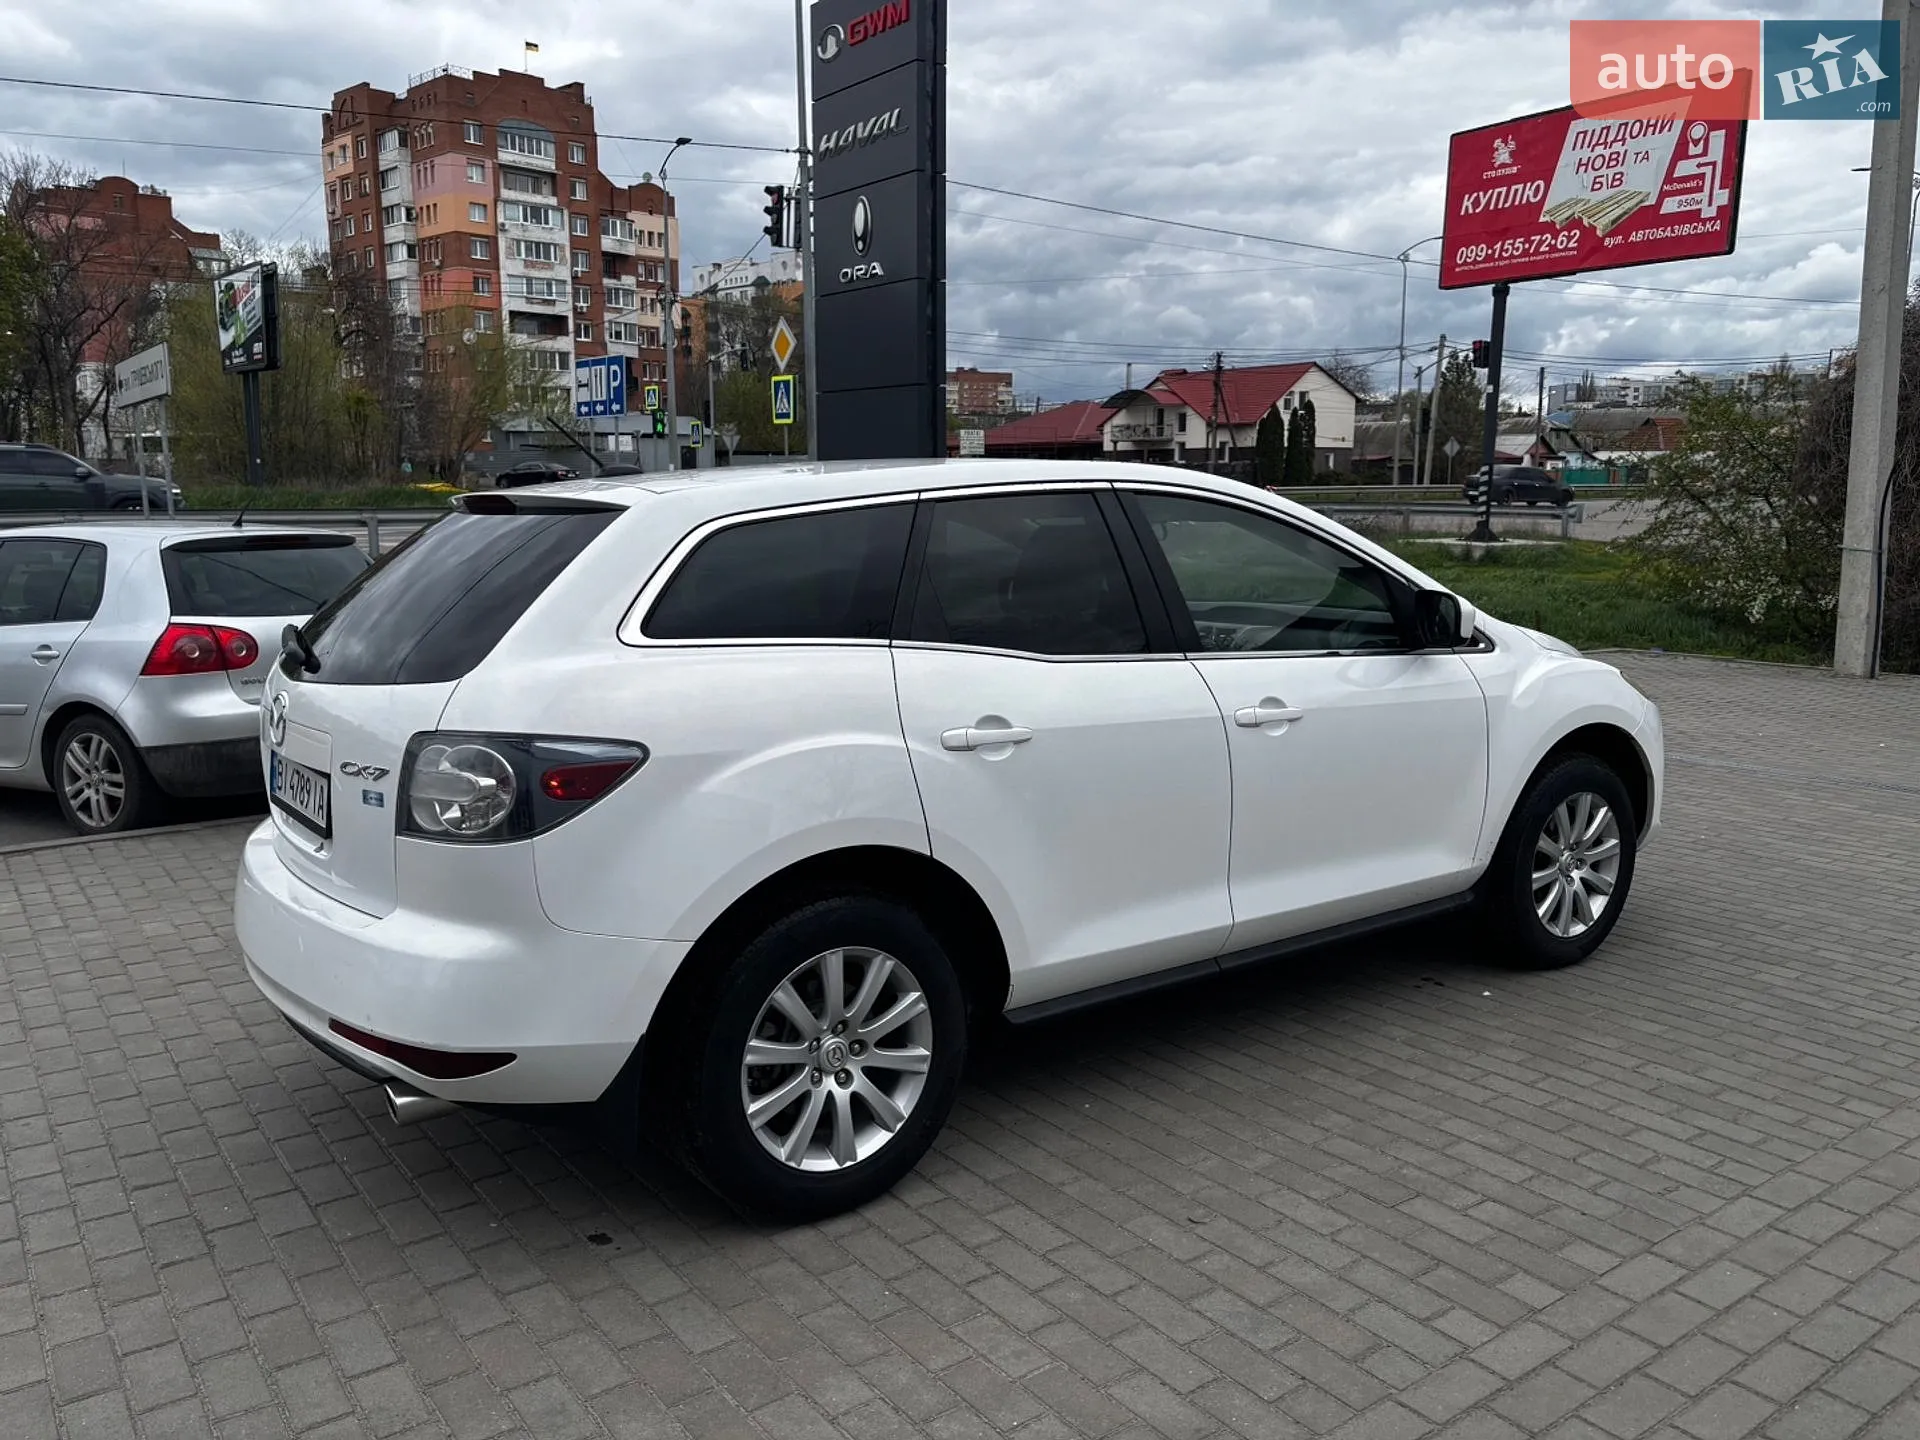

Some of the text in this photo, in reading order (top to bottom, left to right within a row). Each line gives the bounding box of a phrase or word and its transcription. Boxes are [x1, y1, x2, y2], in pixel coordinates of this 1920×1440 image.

[848, 0, 910, 47] GWM
[818, 107, 909, 161] HAVAL
[1572, 112, 1677, 152] ПІДДОНИ
[1575, 149, 1650, 175] НОВІ ТА
[1460, 180, 1545, 216] КУПЛЮ
[1662, 179, 1703, 192] McDonald's
[1603, 219, 1721, 248] вул. АВТОБАЗІВСЬКА
[839, 261, 884, 283] ORA
[609, 364, 621, 400] P
[289, 767, 312, 810] 4789
[340, 760, 390, 782] CX-7
